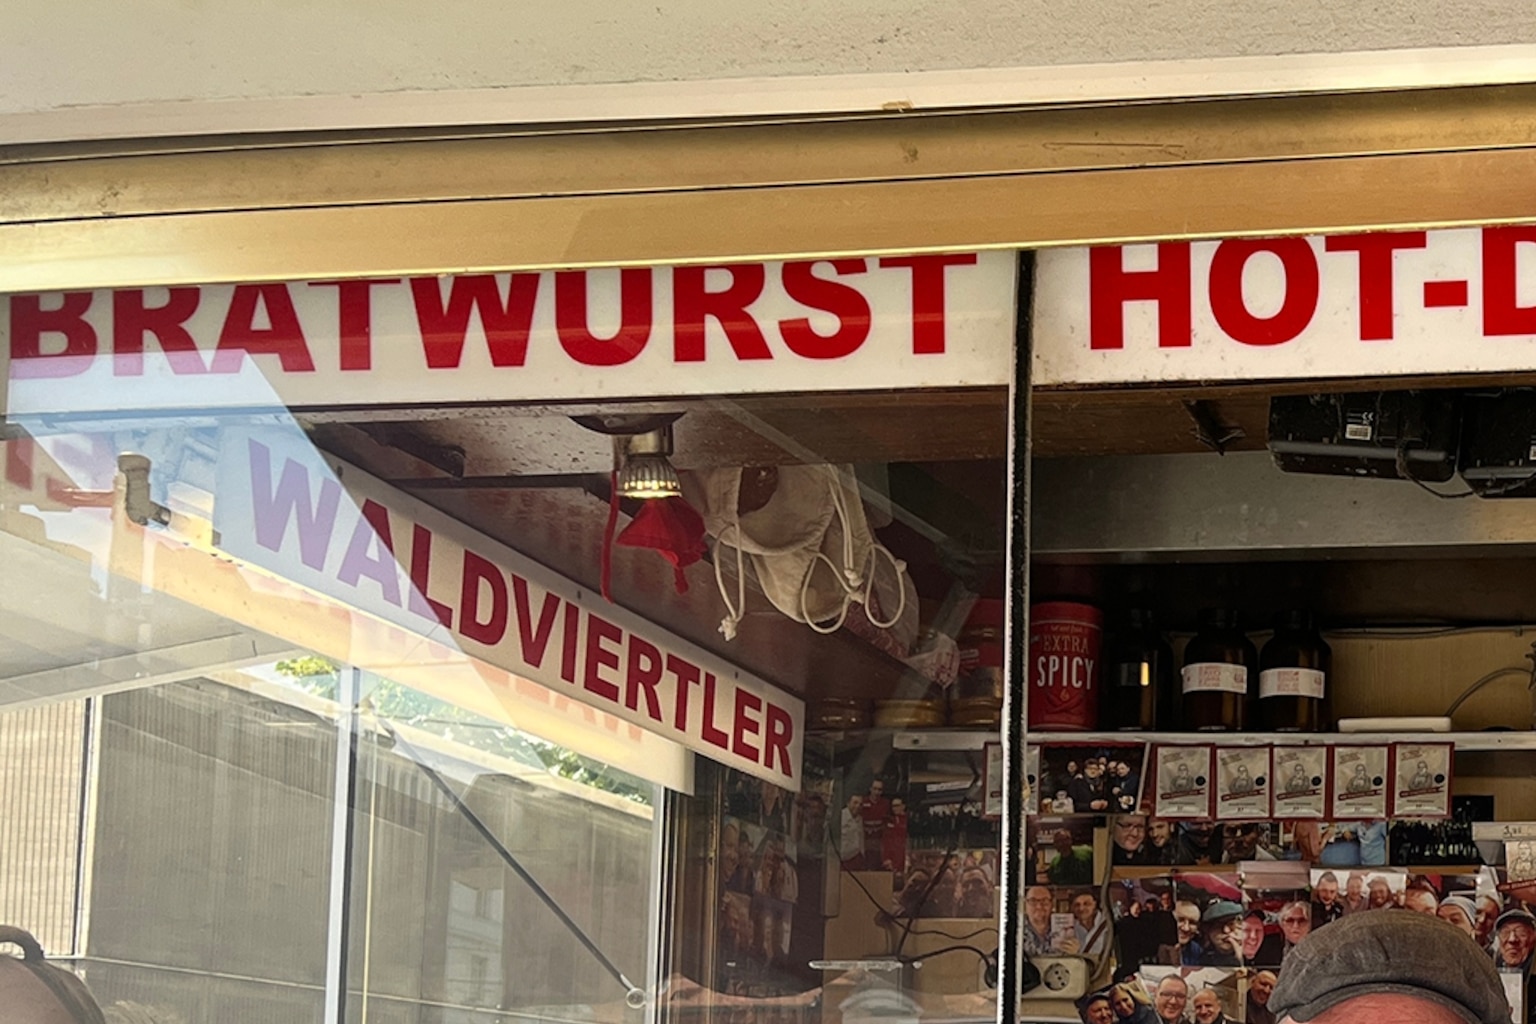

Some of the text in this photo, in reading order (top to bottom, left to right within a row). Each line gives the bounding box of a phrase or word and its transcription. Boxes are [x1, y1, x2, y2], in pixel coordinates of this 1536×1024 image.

[9, 253, 977, 380] BRATWURST
[248, 436, 797, 778] WALDVIERTLER
[1043, 634, 1089, 654] EXTRA
[1037, 655, 1095, 690] SPICY
